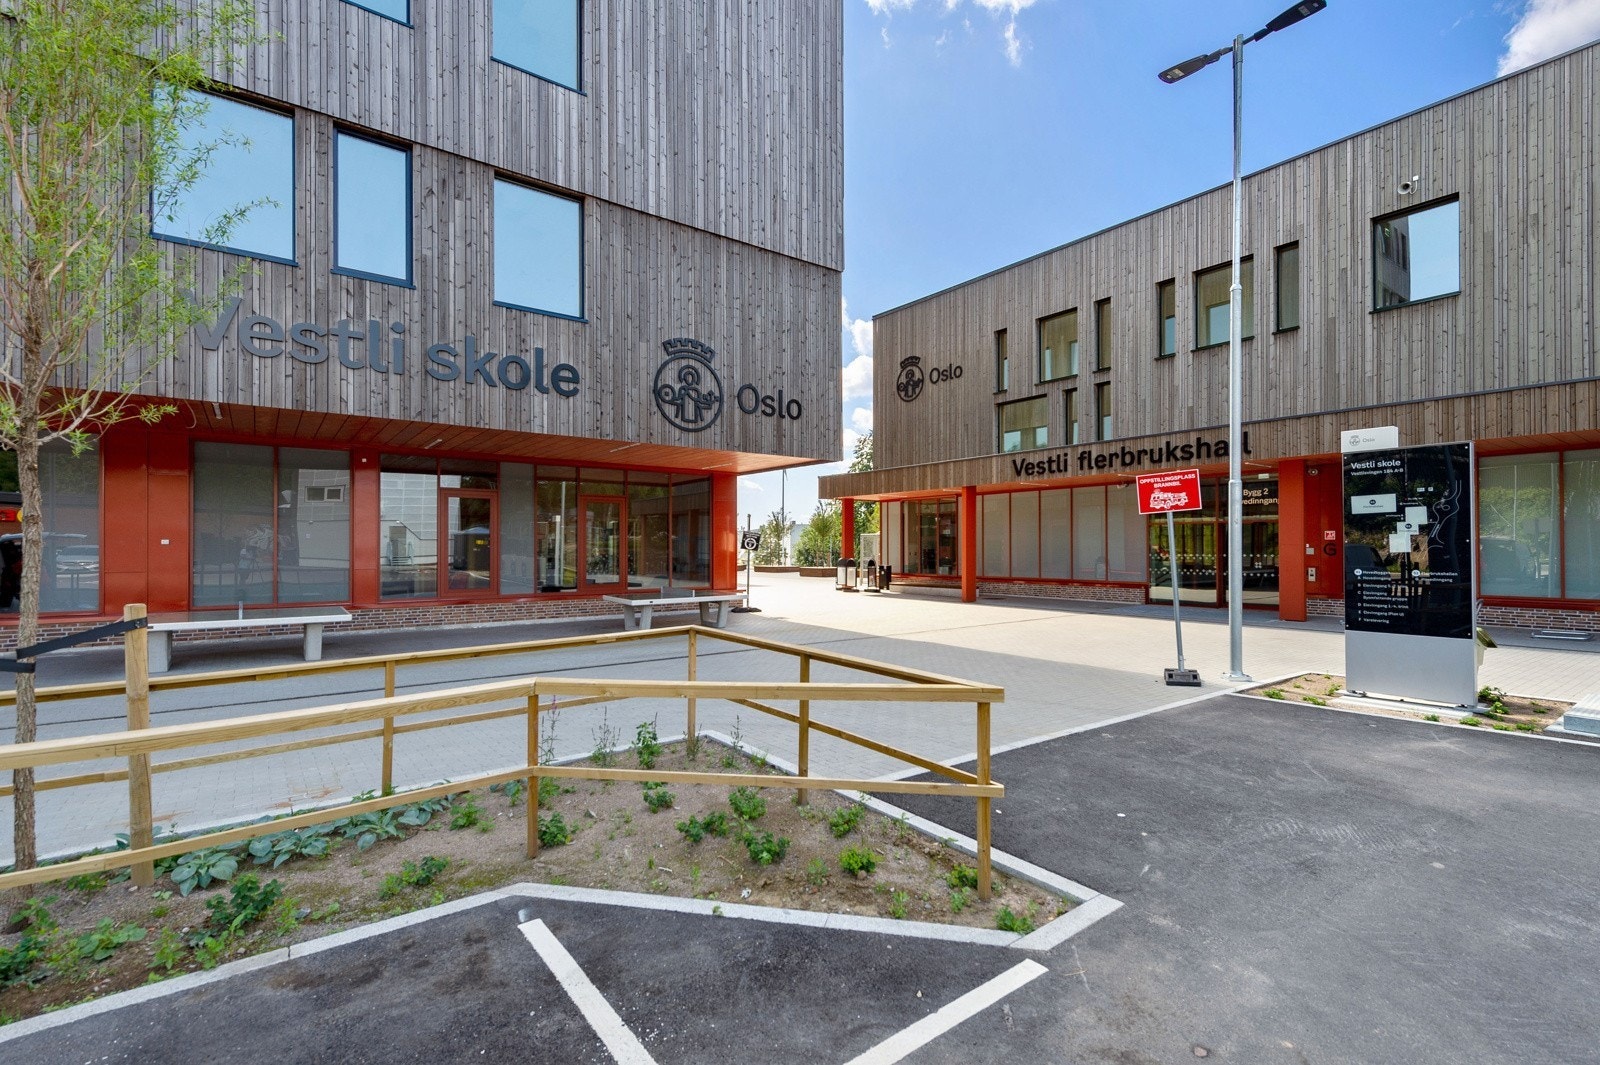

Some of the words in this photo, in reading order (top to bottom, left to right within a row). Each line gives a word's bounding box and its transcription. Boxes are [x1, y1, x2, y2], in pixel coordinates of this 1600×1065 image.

[179, 287, 405, 374] Vestli
[426, 335, 580, 397] skole
[929, 363, 963, 384] Oslo
[737, 383, 802, 420] Oslo
[1012, 453, 1068, 477] Vestli
[1078, 431, 1252, 470] flerbrukshal
[1350, 461, 1376, 469] Vestli
[1377, 459, 1401, 467] skole
[1139, 473, 1196, 484] OPPSTILLINGSPLASS
[1243, 489, 1262, 497] Bygg
[1263, 487, 1269, 495] 2
[1323, 542, 1337, 556] G
